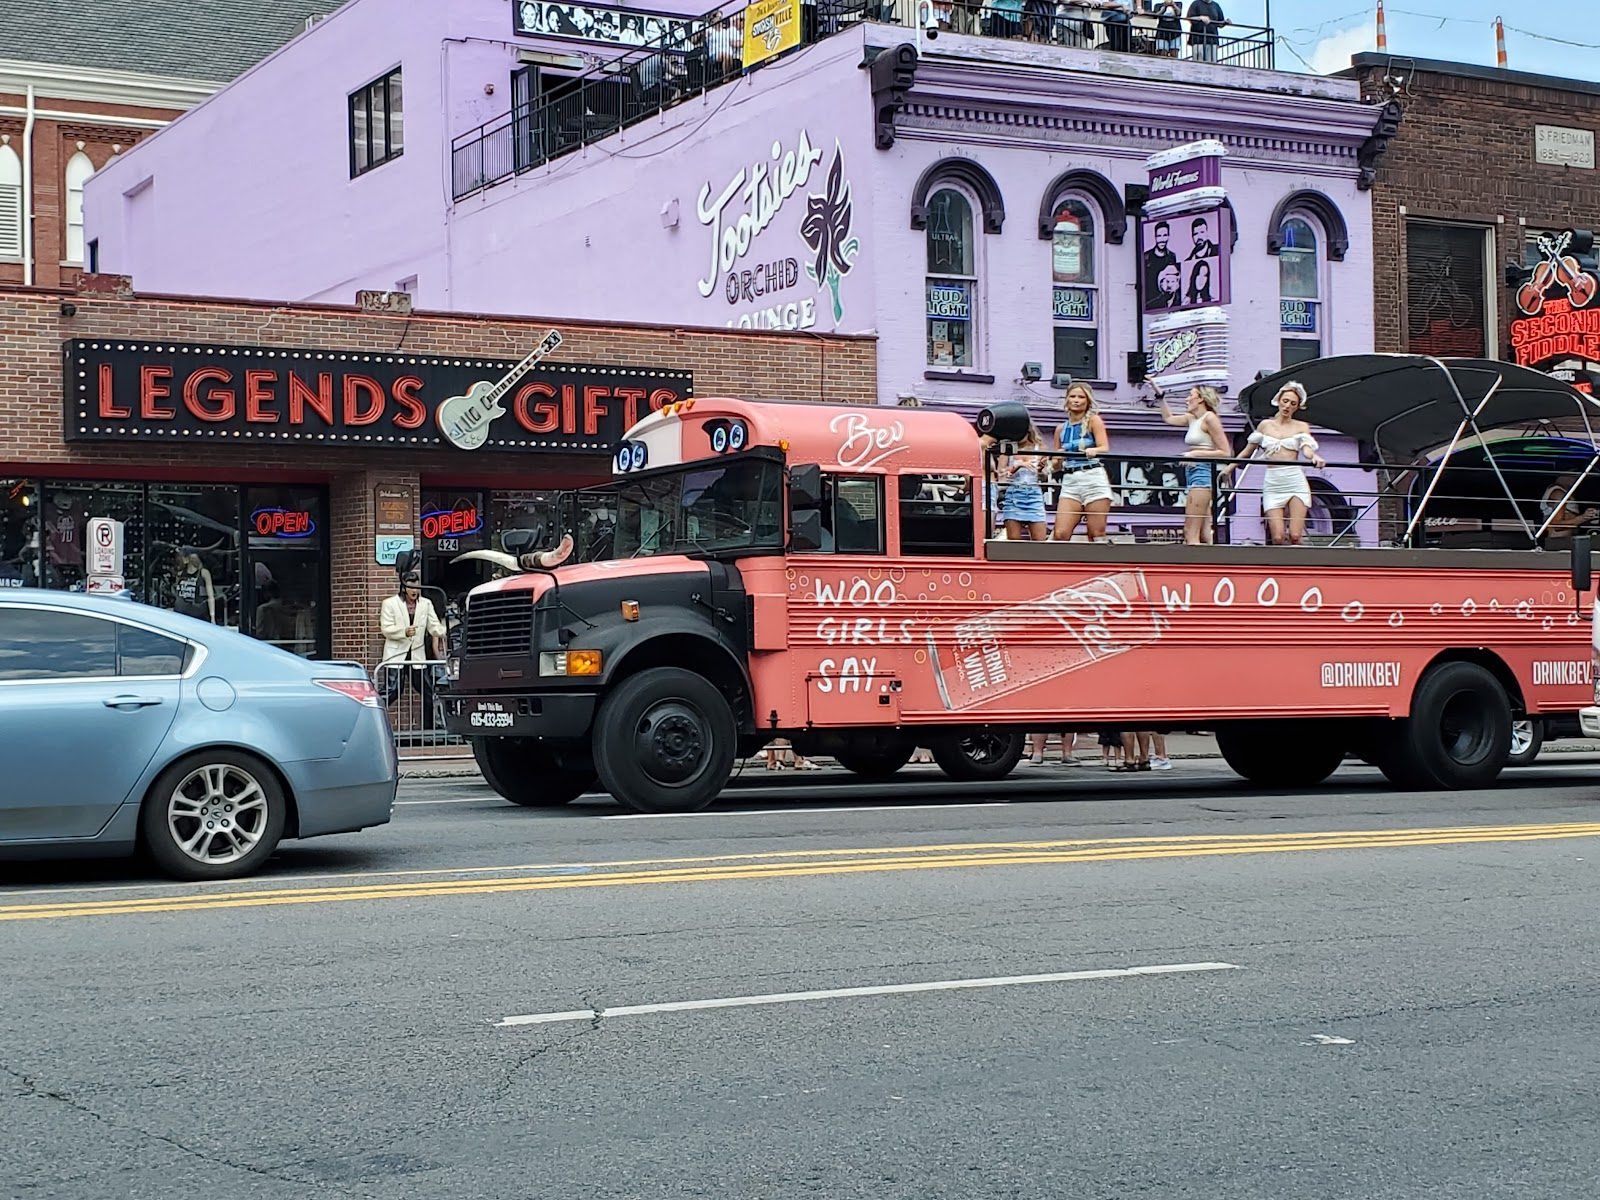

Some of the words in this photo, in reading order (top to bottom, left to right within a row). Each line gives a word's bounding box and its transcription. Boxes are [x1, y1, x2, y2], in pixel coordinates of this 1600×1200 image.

[1547, 131, 1591, 145] FRIEDMAN
[697, 128, 822, 298] Tootsies
[726, 257, 798, 304] ORCHID
[927, 302, 969, 317] LIGHT
[930, 289, 963, 303] BUD
[1053, 290, 1081, 304] BUD
[1280, 301, 1306, 313] BUD
[1543, 298, 1572, 314] THE
[1053, 303, 1089, 317] IGHT
[1280, 312, 1311, 326] IGHT
[1511, 308, 1600, 346] SECOND
[1515, 334, 1600, 366] FIDDLE
[98, 362, 427, 430] LEGENDS
[256, 511, 310, 536] OPEN
[423, 508, 477, 539] OPEN
[439, 539, 457, 550] 424
[814, 577, 896, 608] WOO
[816, 616, 914, 646] GIRLS
[817, 656, 888, 694] SAY.
[963, 651, 989, 692] WINE
[1320, 661, 1401, 688] @DRINKBEV
